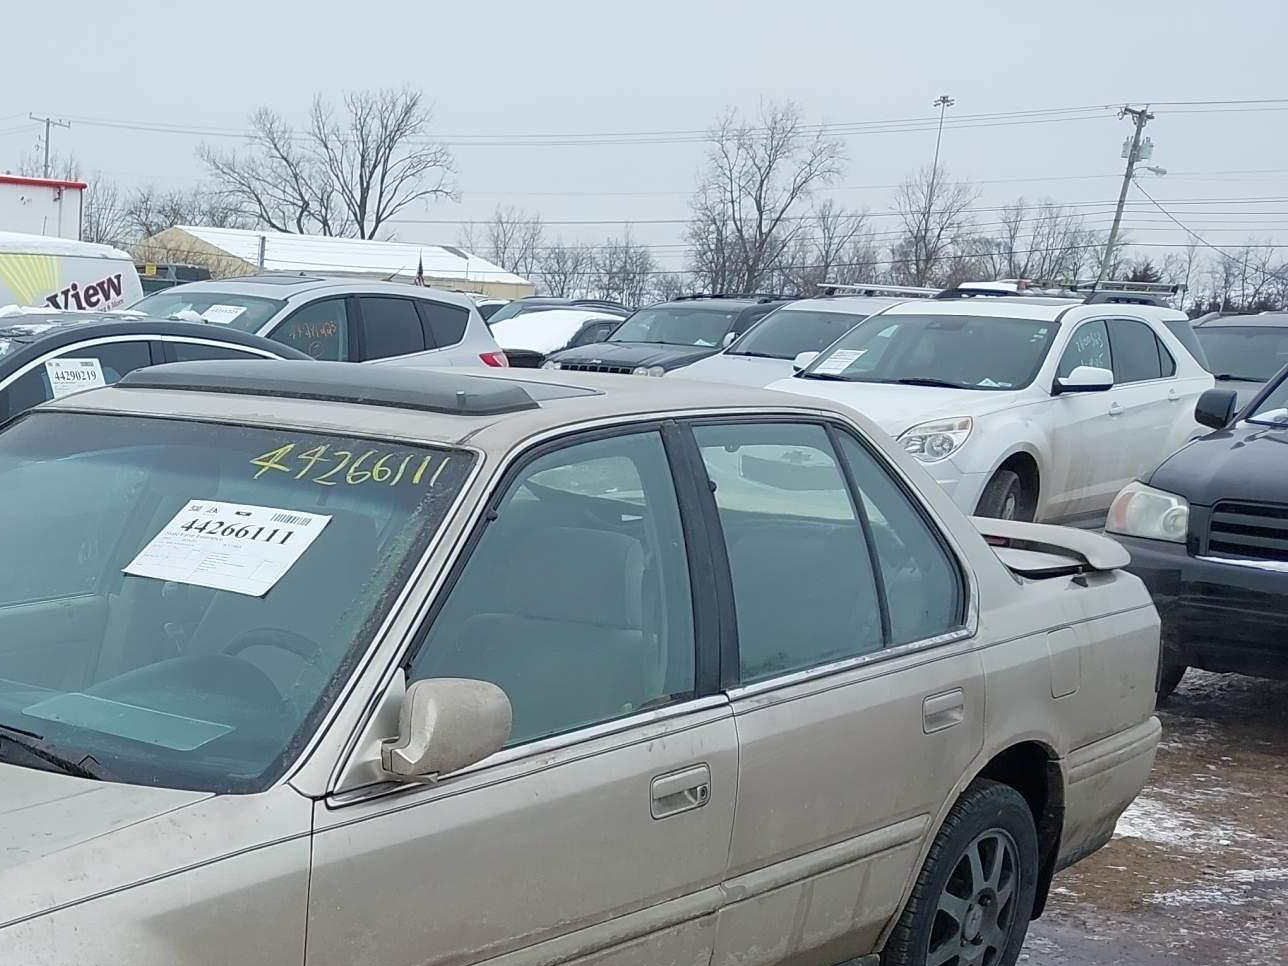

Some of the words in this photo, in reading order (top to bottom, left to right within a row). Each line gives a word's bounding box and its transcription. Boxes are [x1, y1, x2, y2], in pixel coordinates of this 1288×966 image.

[54, 370, 97, 380] 44290219
[249, 443, 451, 487] 44266111
[180, 518, 295, 545] 44266111
